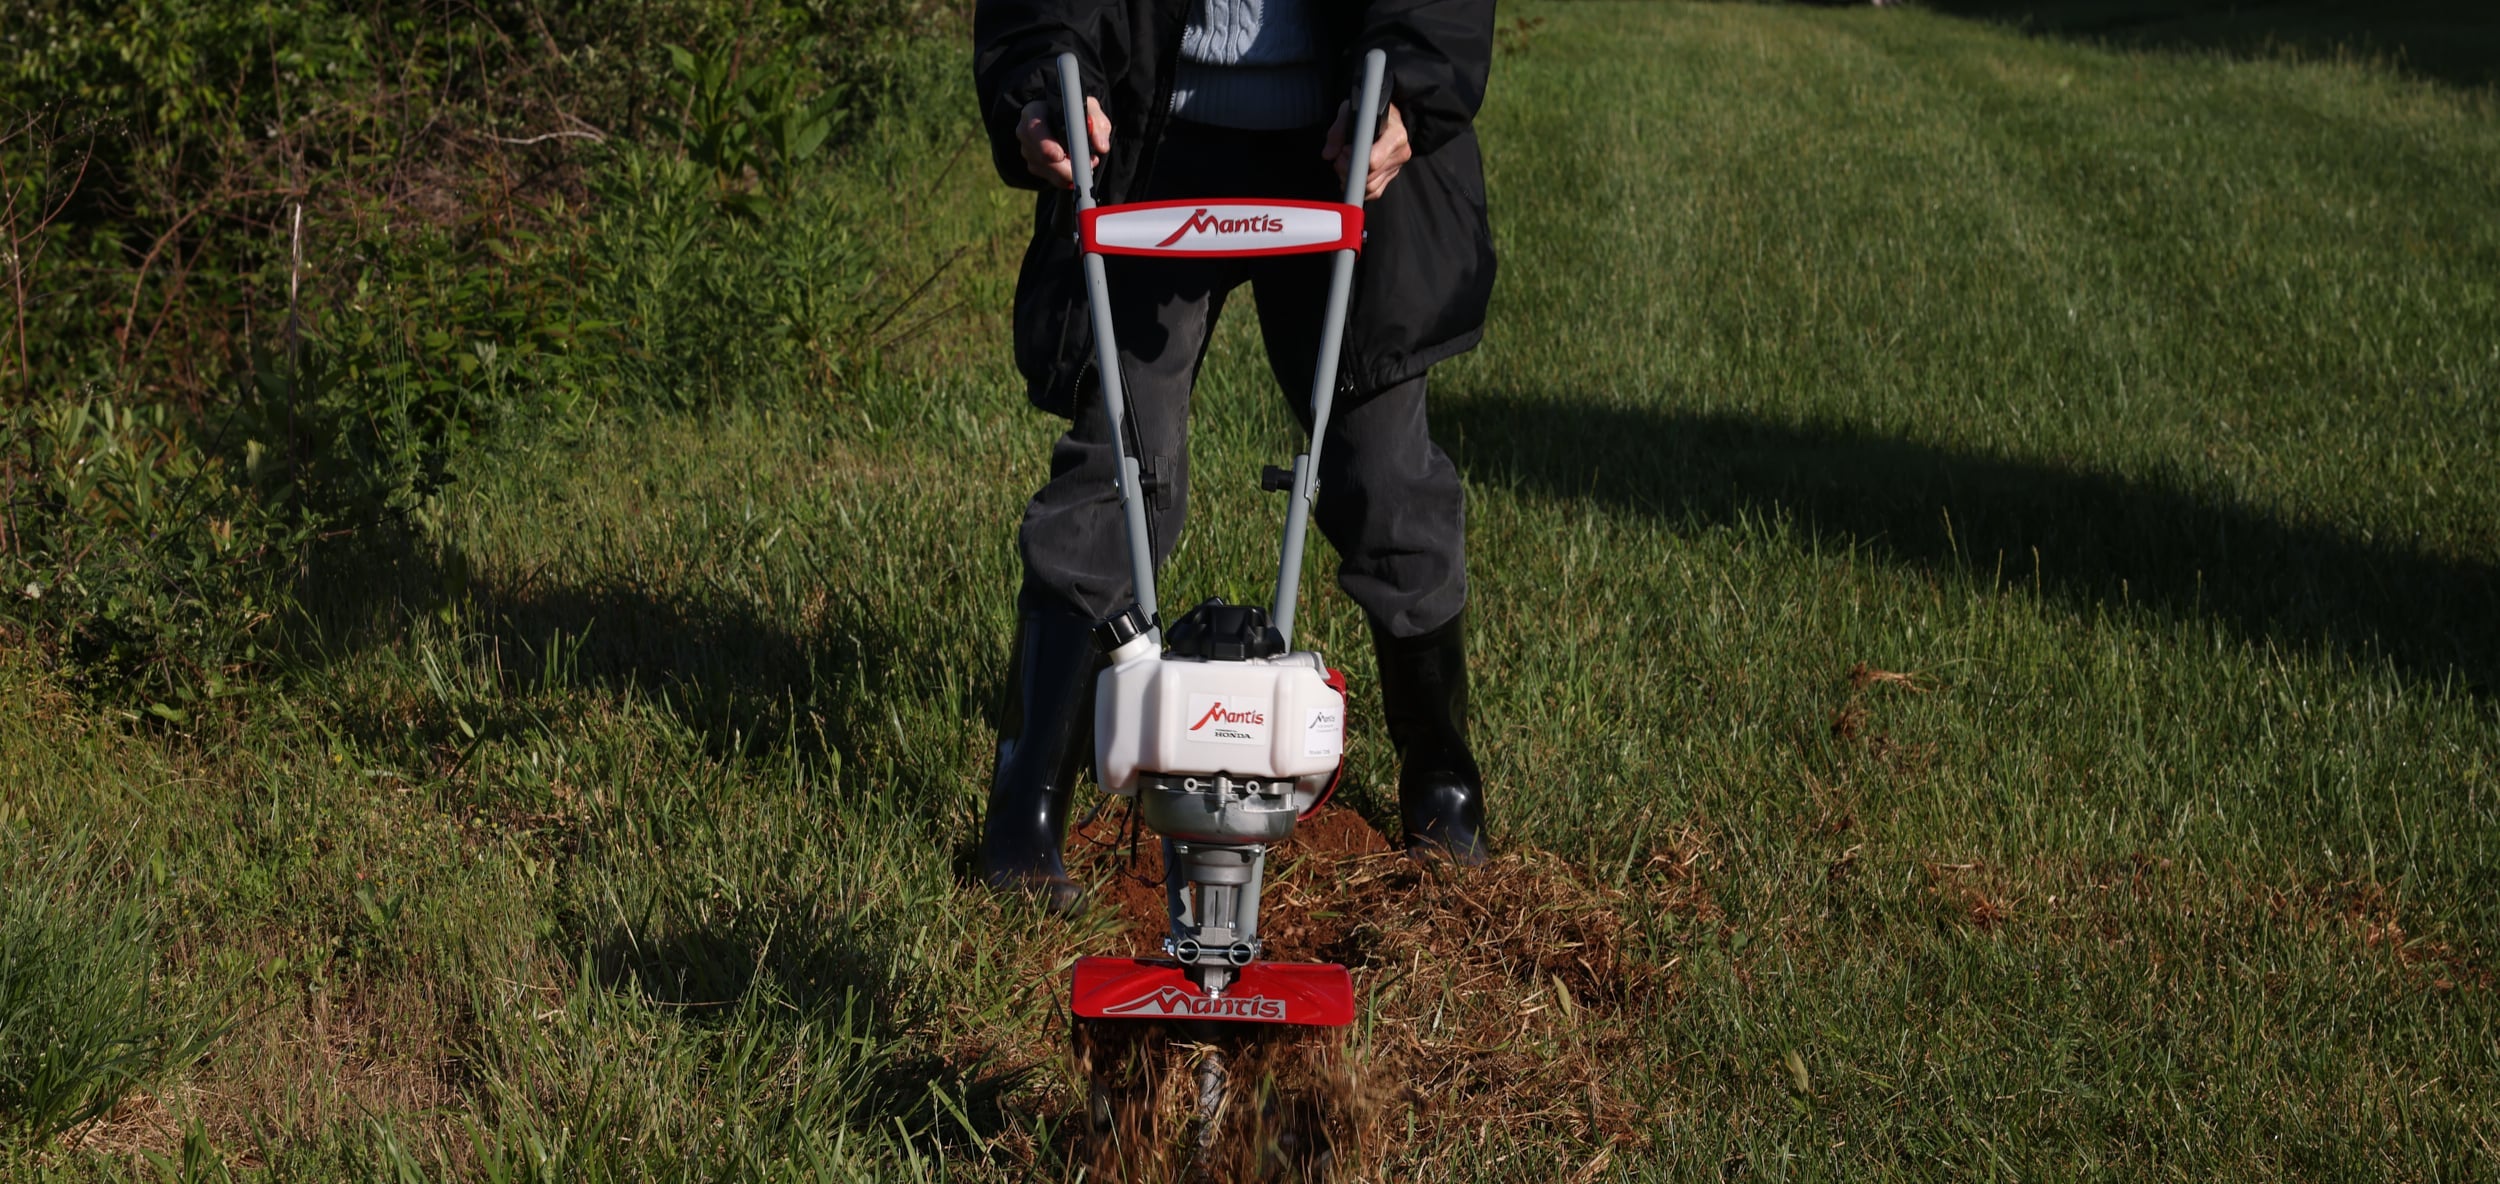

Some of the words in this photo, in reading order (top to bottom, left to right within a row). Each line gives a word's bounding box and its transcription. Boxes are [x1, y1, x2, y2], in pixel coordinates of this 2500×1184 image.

[1155, 208, 1283, 247] Mantis
[1189, 702, 1264, 730] Mantis
[1106, 987, 1281, 1018] Mantis
